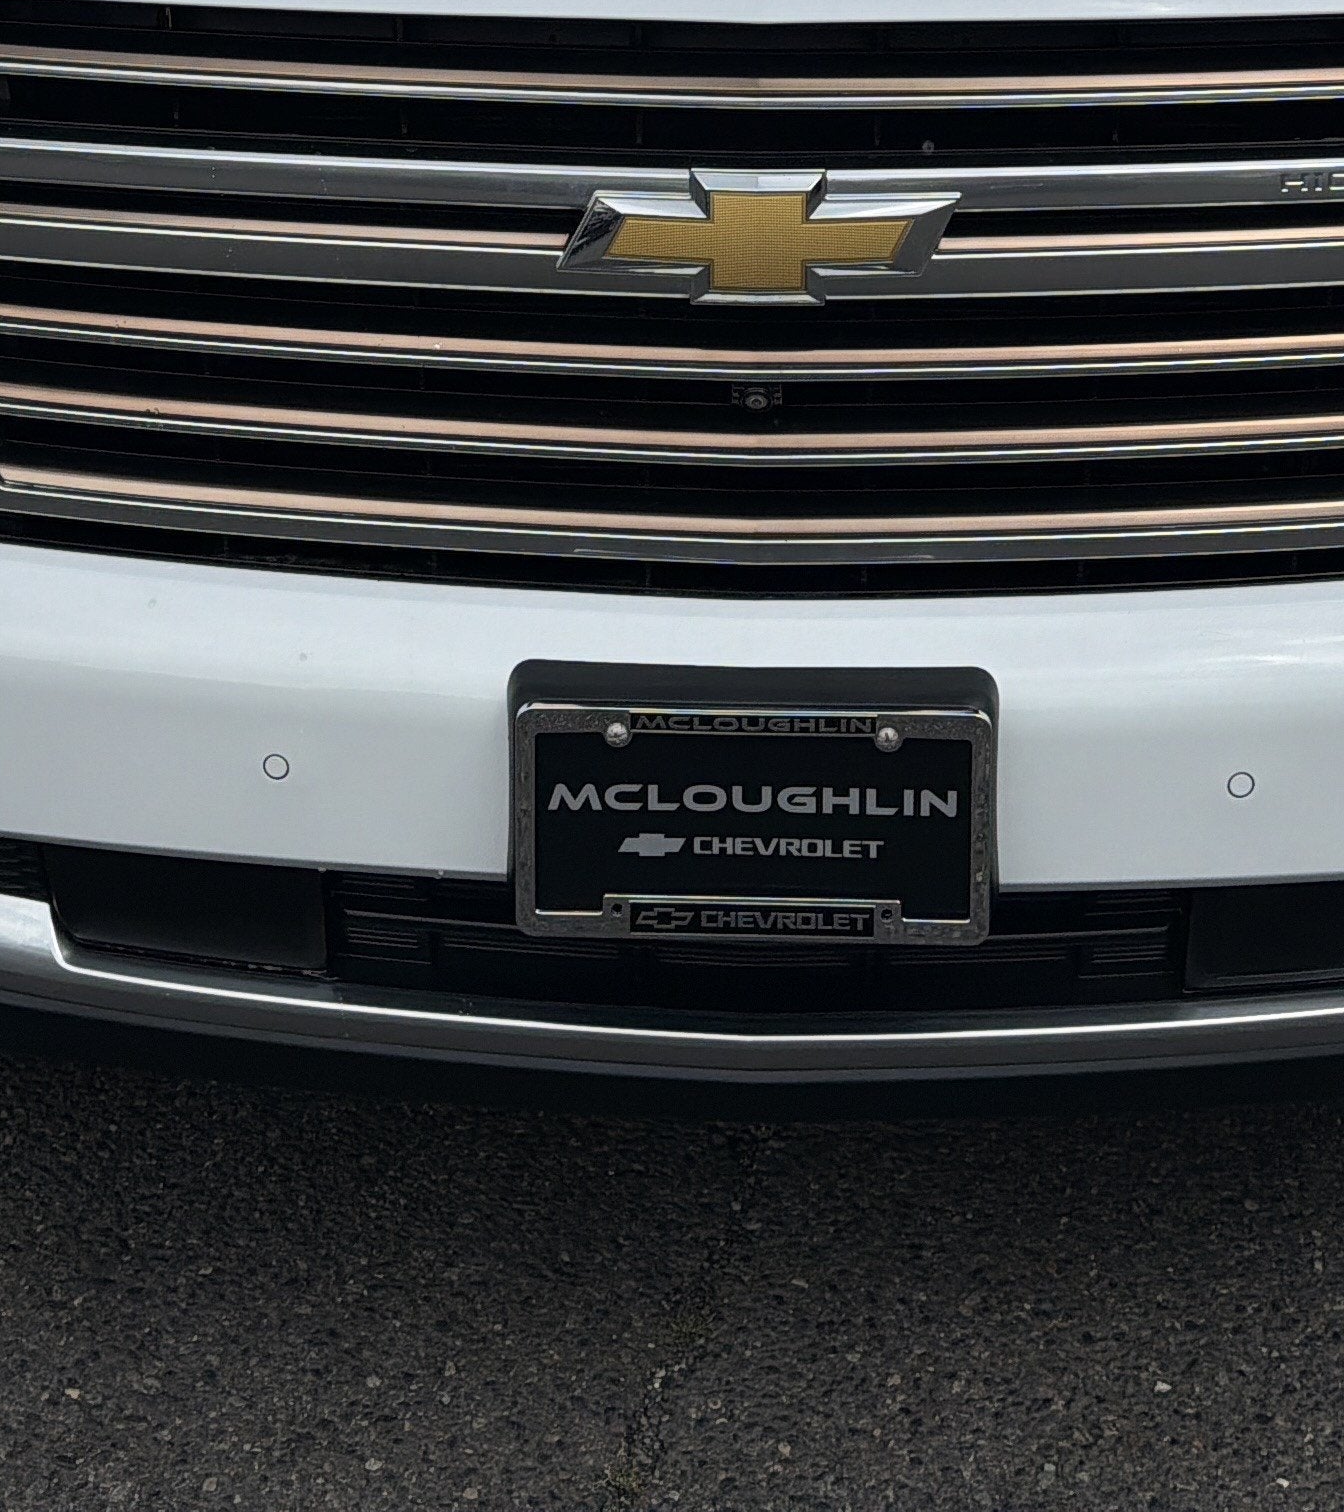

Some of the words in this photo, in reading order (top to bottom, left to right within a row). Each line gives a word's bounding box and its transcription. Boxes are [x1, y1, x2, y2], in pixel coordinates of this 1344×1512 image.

[635, 715, 872, 733] MCLOUGHLIN
[547, 782, 958, 818] MCLOUGHLIN
[693, 836, 885, 859] CHEVROLET
[700, 910, 870, 931] CHEVROLET
